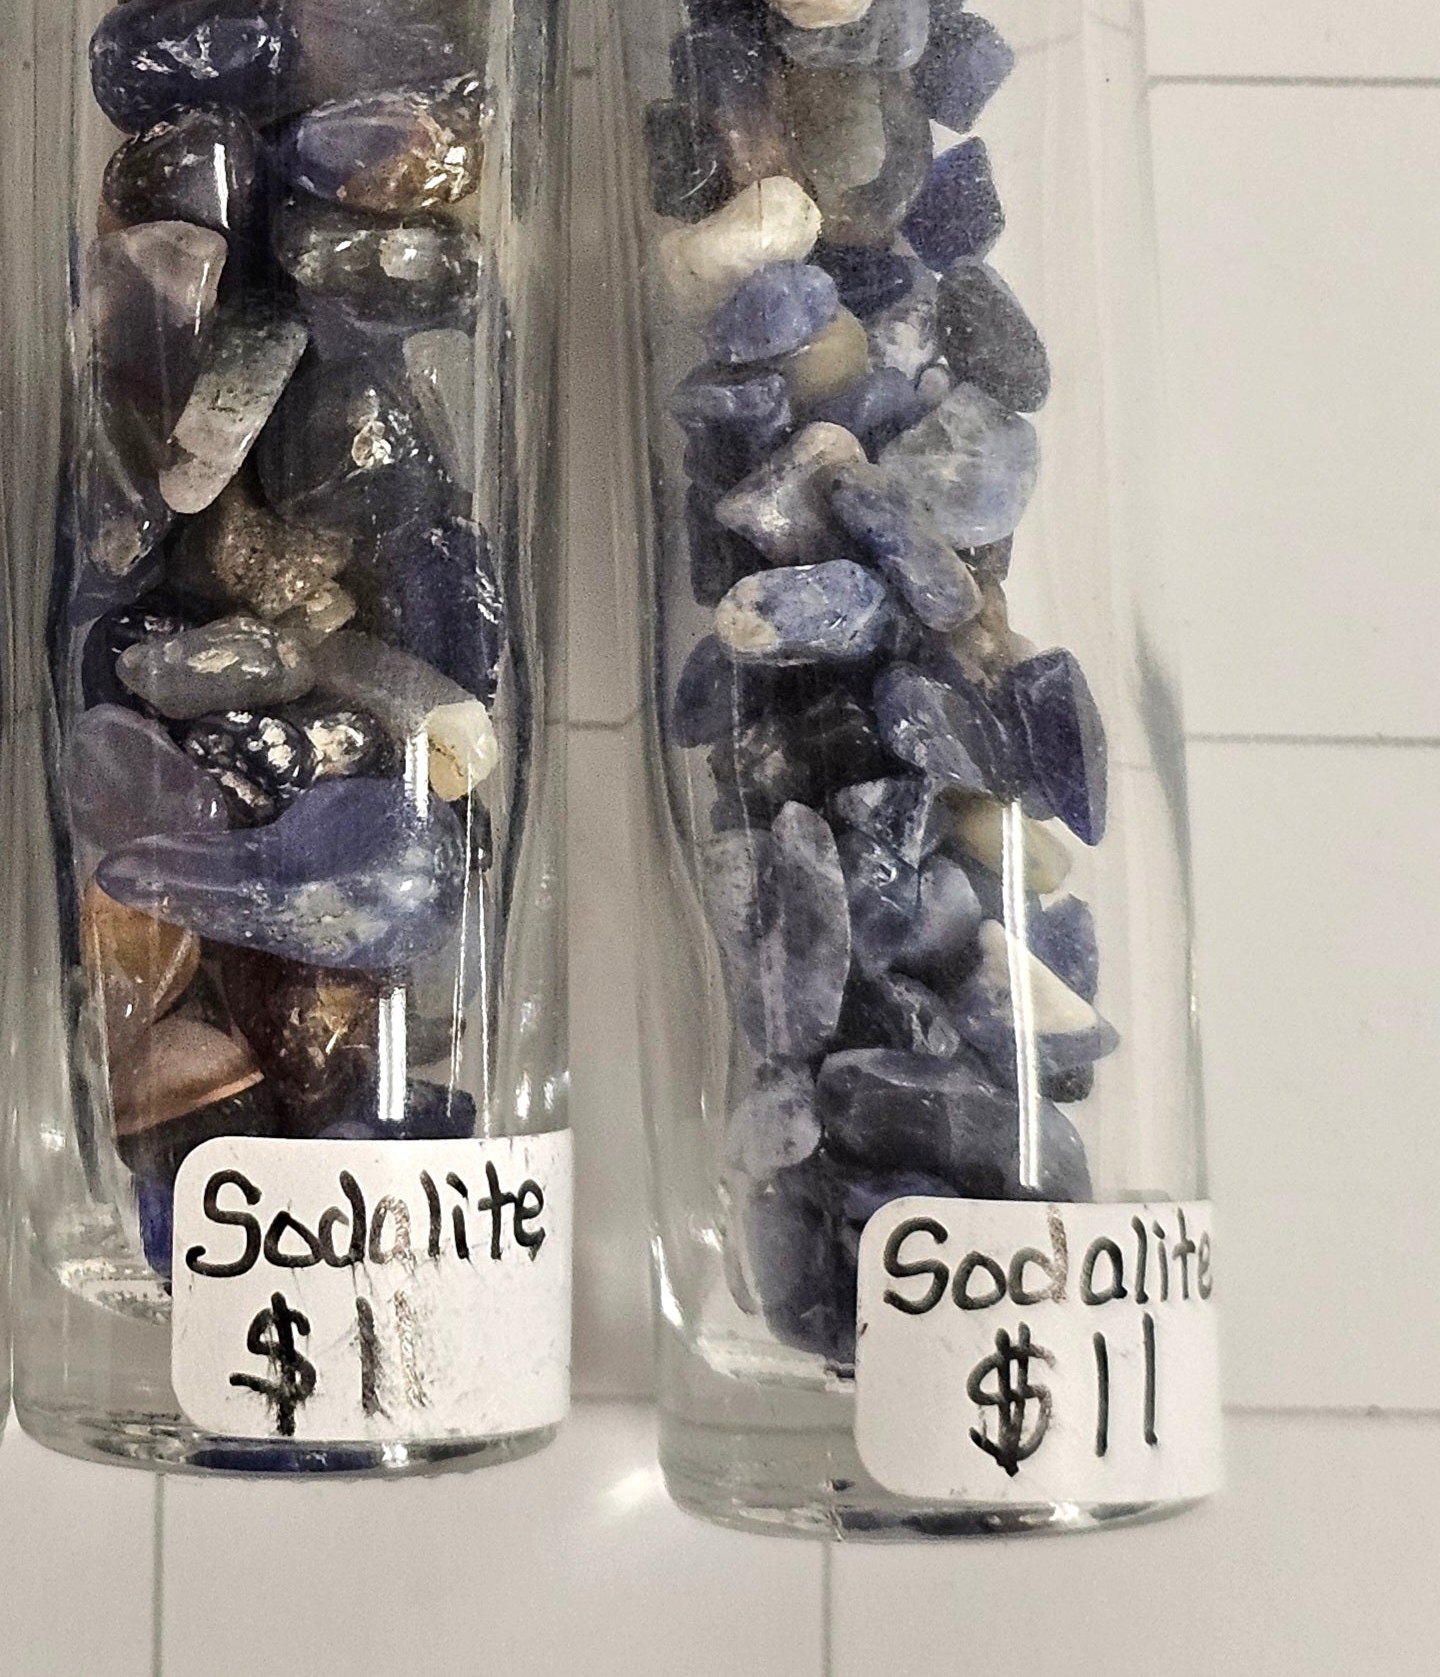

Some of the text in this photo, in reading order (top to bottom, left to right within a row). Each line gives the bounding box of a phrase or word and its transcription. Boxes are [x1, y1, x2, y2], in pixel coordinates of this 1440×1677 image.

[185, 1159, 547, 1278] Sodalite
[882, 1206, 1214, 1315] Sodalite
[966, 1311, 1160, 1478] $11
